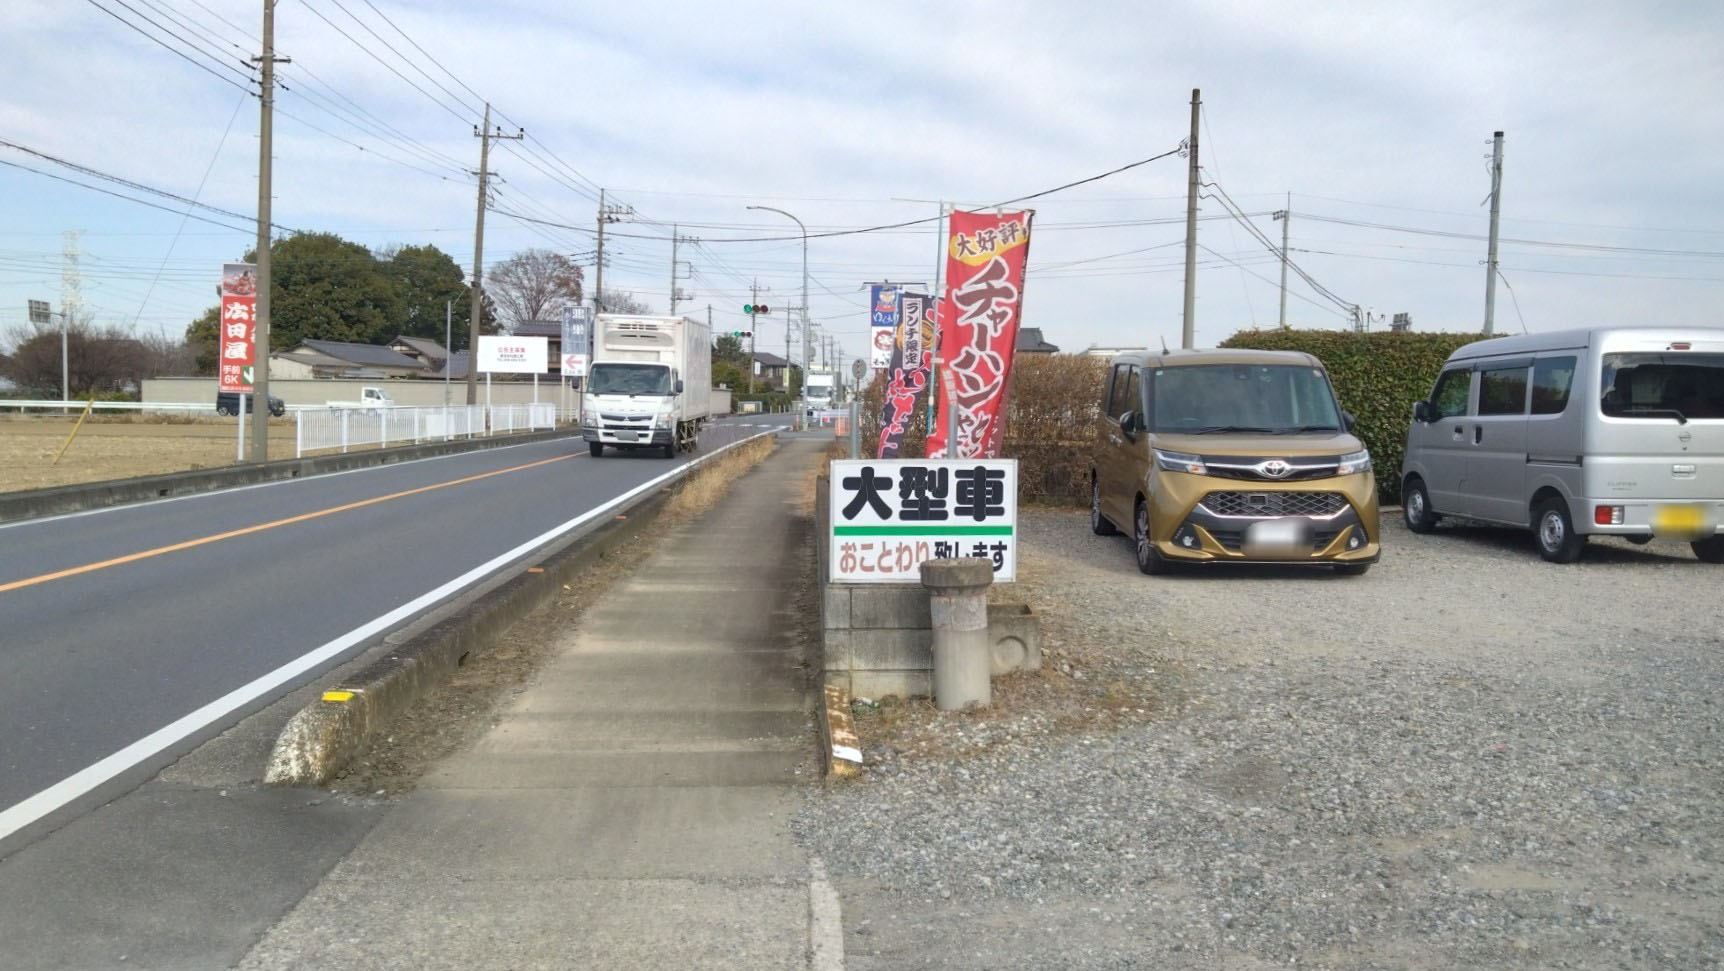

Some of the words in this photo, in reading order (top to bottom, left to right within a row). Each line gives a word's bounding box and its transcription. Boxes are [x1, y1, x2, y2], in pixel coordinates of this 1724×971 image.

[904, 302, 919, 365] ランチ限定
[950, 256, 1018, 411] チャーハン
[223, 365, 240, 375] 手前
[842, 466, 1006, 522] 大型車
